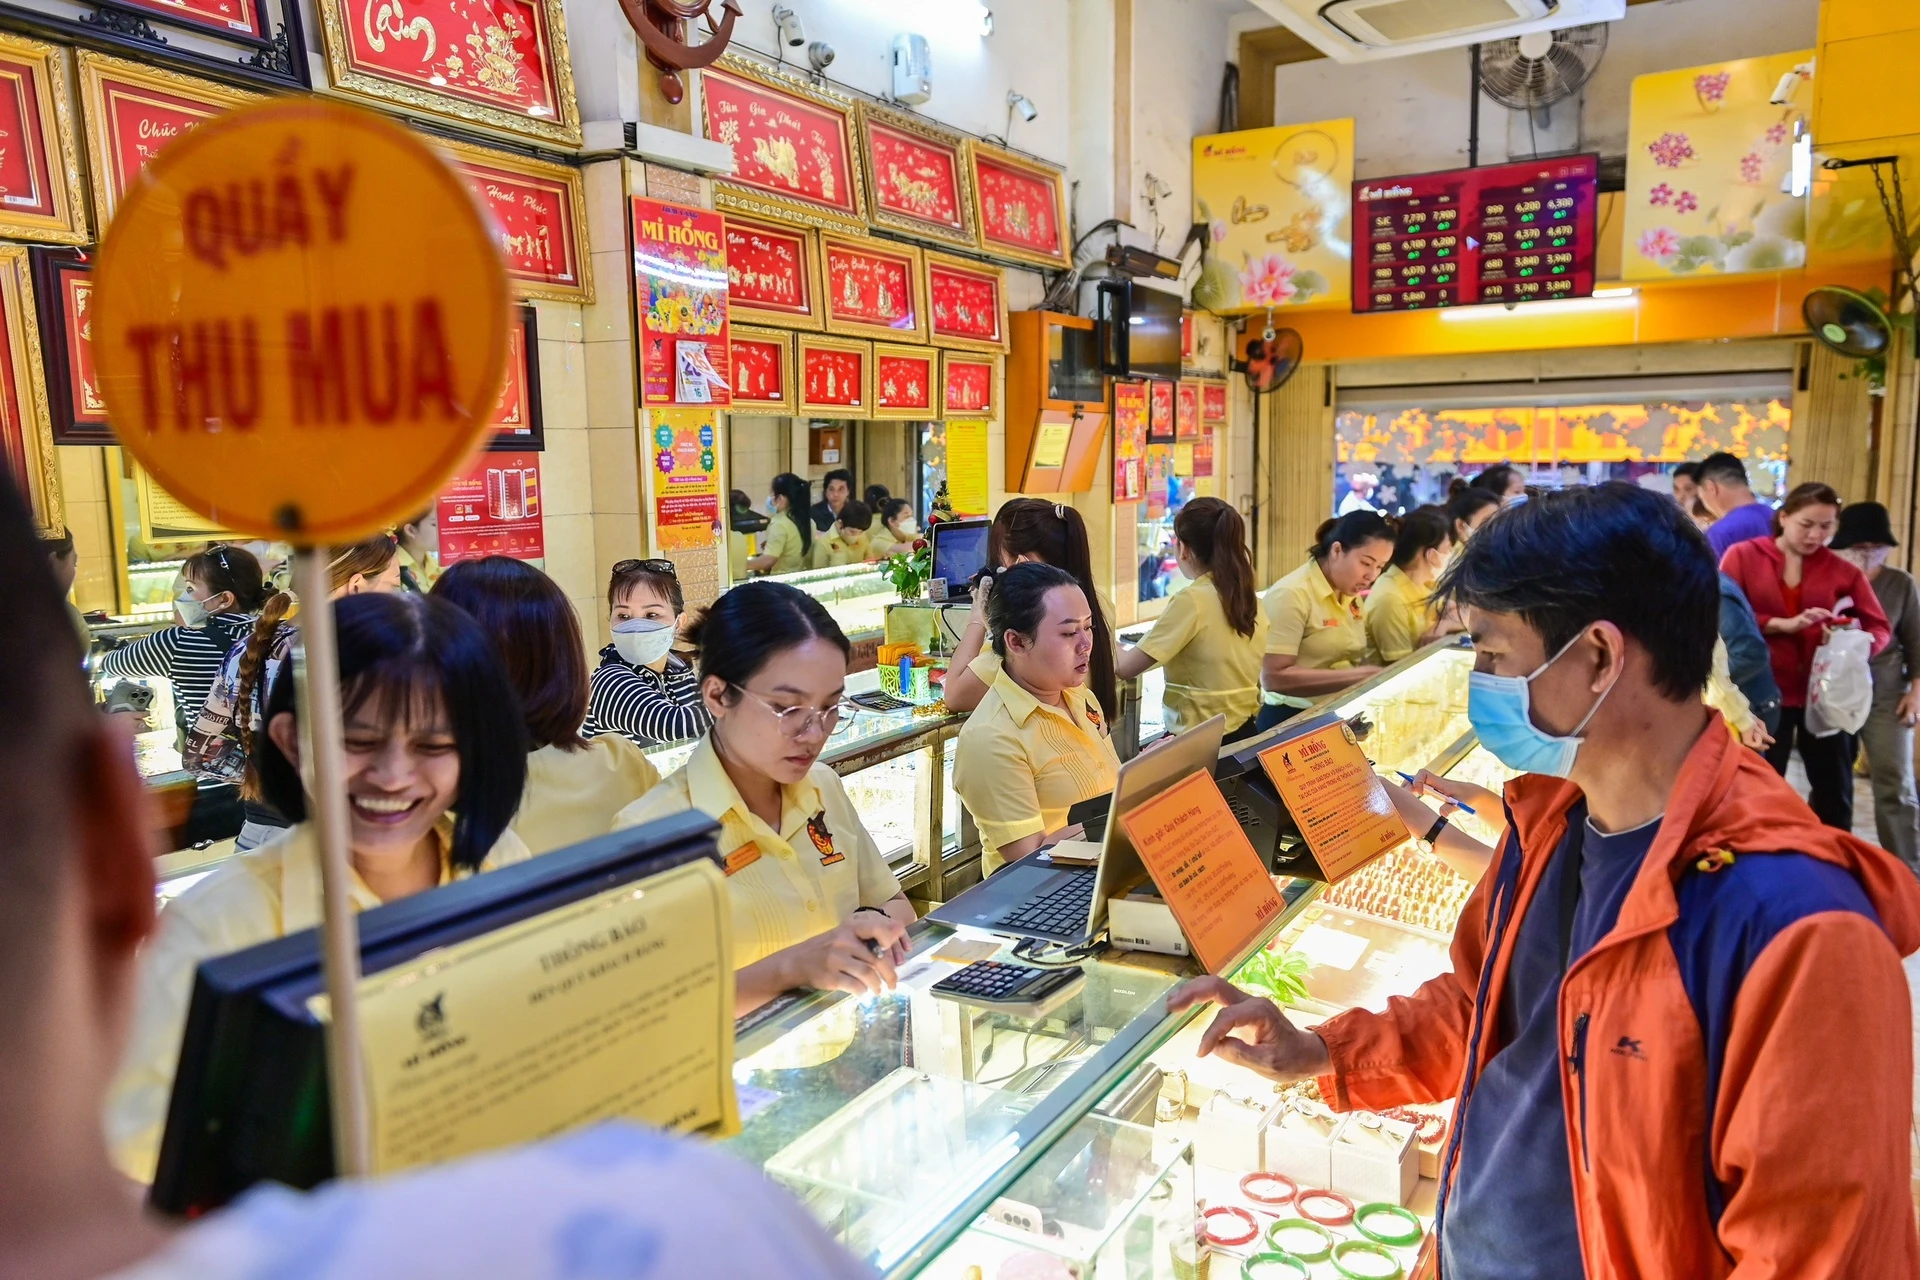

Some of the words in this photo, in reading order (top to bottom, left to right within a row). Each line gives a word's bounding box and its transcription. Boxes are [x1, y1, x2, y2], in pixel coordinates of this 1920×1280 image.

[139, 119, 178, 138] Chúc
[1486, 205, 1504, 215] 999
[1515, 201, 1541, 213] 6,200
[1547, 198, 1573, 210] 6,300
[1375, 216, 1391, 227] SJC
[1487, 232, 1504, 242] 750
[1514, 229, 1540, 240] 4,370
[1546, 225, 1573, 237] 4,470
[1402, 265, 1426, 277] 6,070
[1431, 263, 1456, 275] 6,170
[1439, 290, 1447, 300] 0
[1484, 286, 1502, 296] 610
[126, 314, 263, 433] THU
[286, 296, 460, 429] MUA
[1310, 762, 1326, 773] THÔNG
[1324, 757, 1334, 768] BÁO
